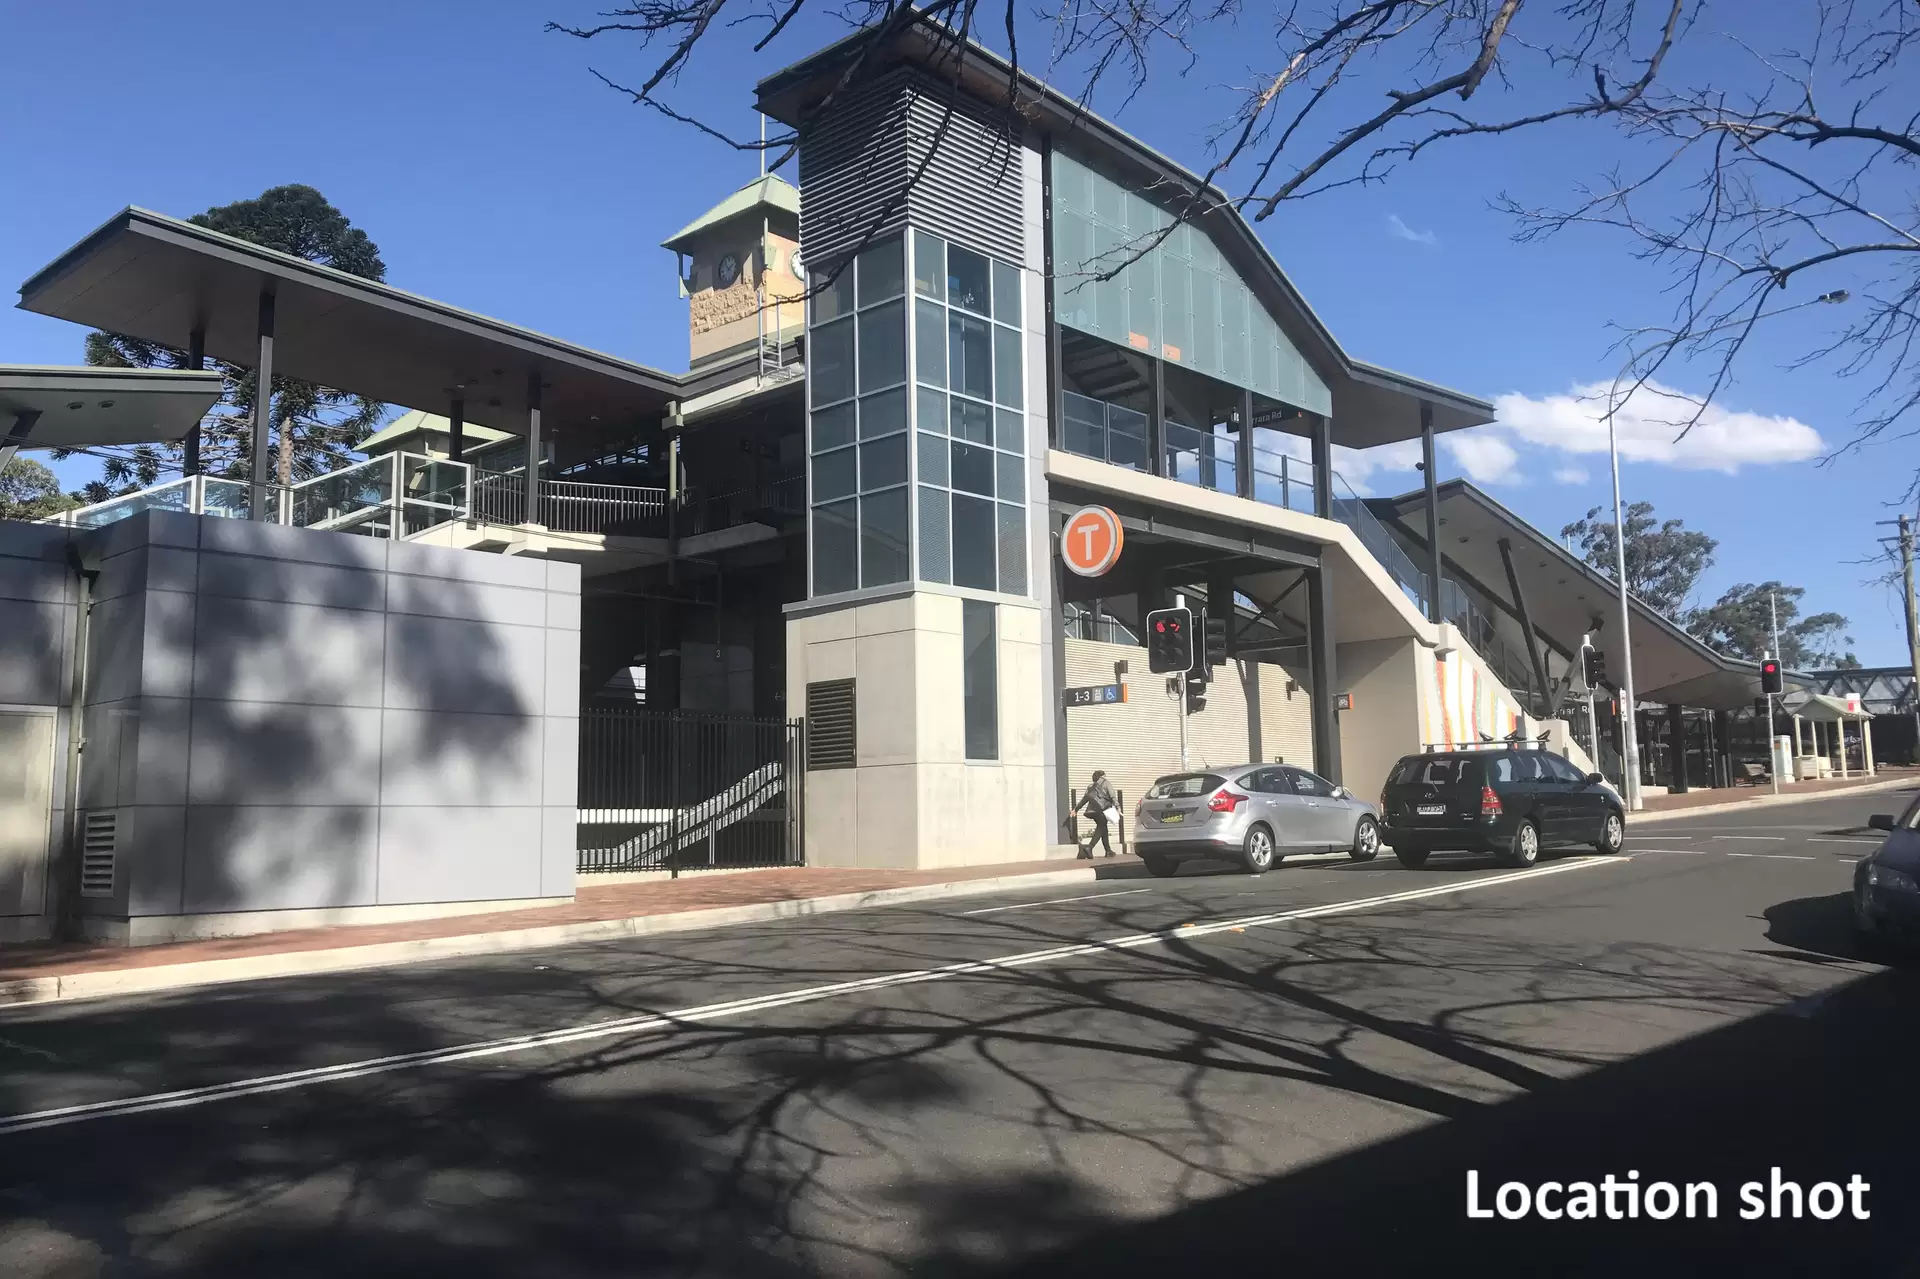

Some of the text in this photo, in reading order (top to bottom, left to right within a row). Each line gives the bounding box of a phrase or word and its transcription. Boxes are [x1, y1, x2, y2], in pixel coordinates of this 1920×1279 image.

[1271, 410, 1282, 420] Rd
[1077, 523, 1100, 561] T
[715, 649, 721, 658] 3
[1074, 691, 1090, 702] 1-3
